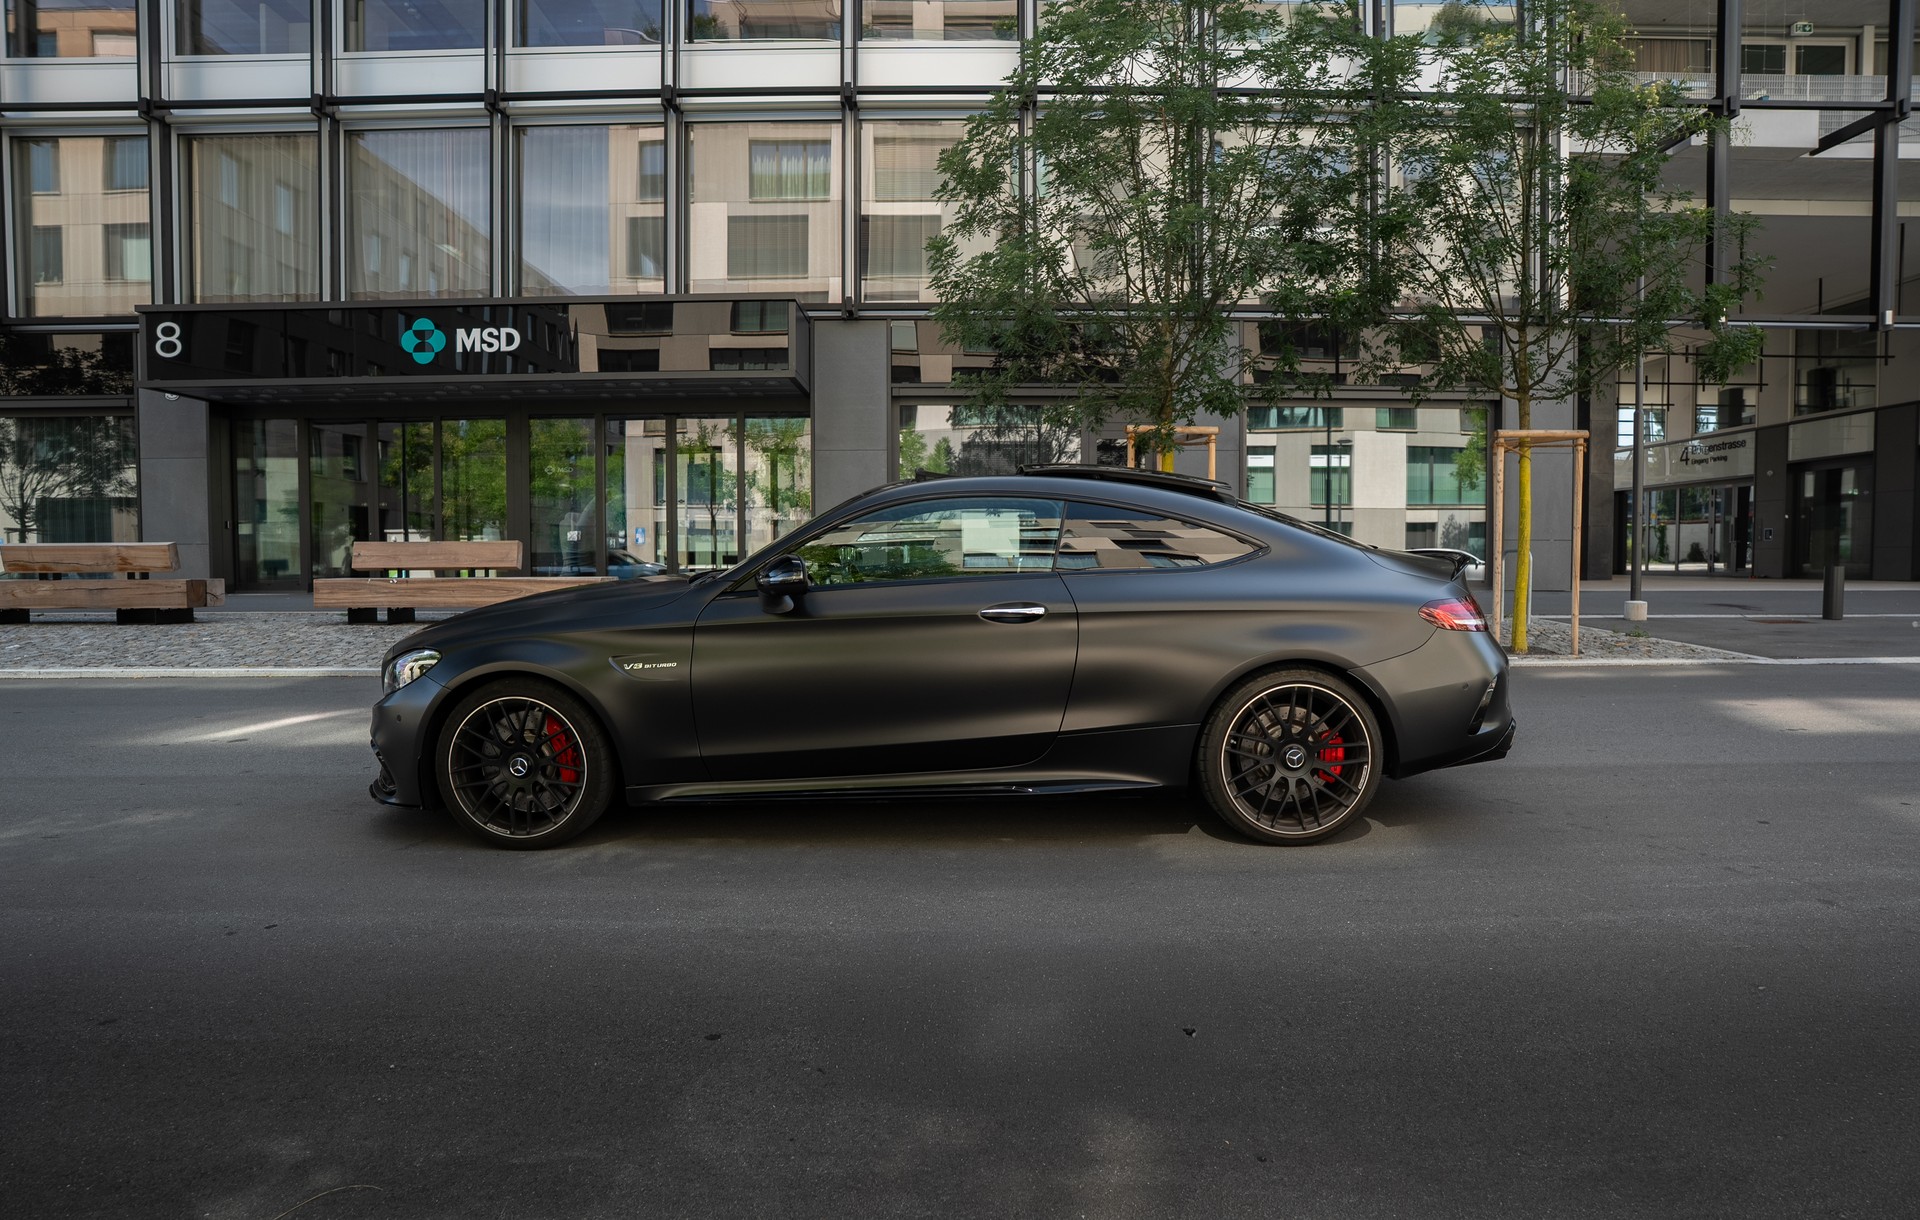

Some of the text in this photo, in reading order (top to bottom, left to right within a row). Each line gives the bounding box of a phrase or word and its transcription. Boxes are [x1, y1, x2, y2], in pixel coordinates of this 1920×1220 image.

[155, 321, 182, 358] 8
[456, 327, 521, 353] MSD
[1680, 446, 1690, 465] 4
[623, 662, 643, 670] V8
